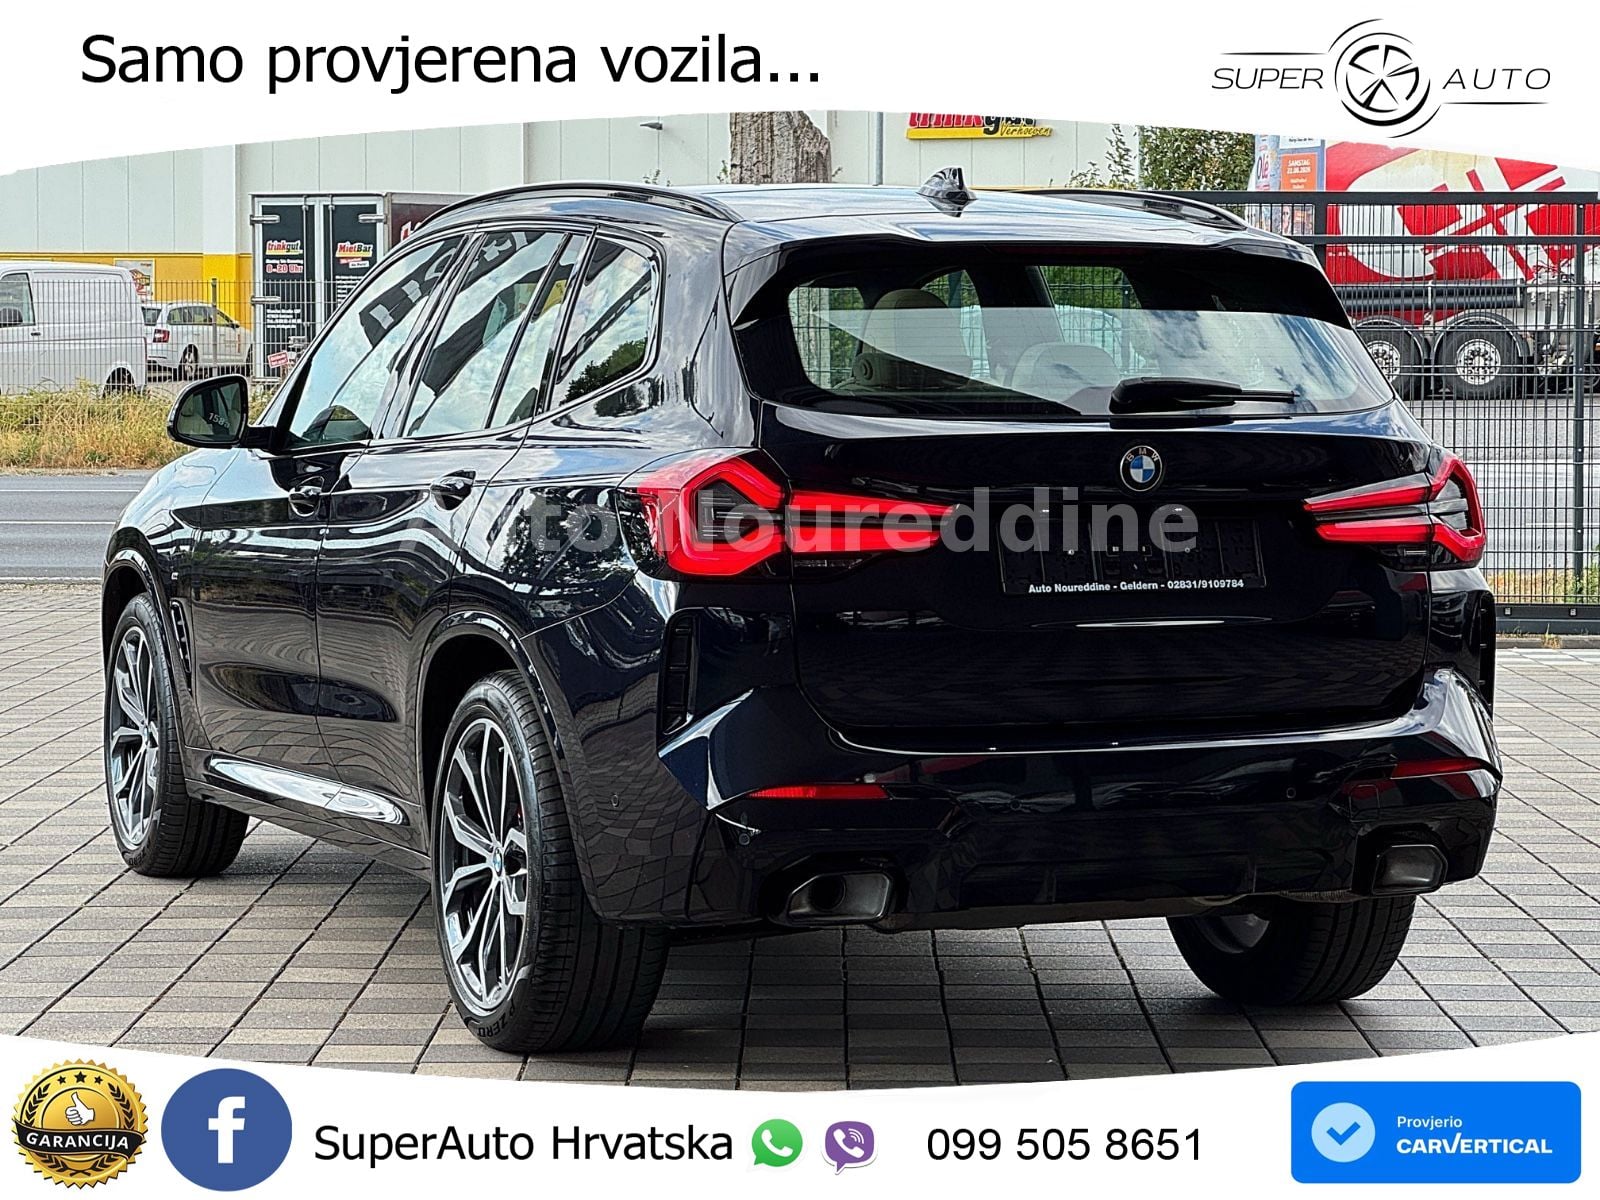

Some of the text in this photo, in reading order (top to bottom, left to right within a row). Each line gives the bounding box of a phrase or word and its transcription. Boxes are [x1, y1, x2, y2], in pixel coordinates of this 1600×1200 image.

[267, 240, 300, 253] trinkgut
[338, 243, 372, 253] MietBar
[1126, 448, 1159, 461] BMW
[1028, 584, 1052, 593] Auto
[1054, 582, 1111, 592] Noureddine
[1120, 581, 1158, 591] Geldern
[1167, 579, 1245, 589] 02831/9109784
